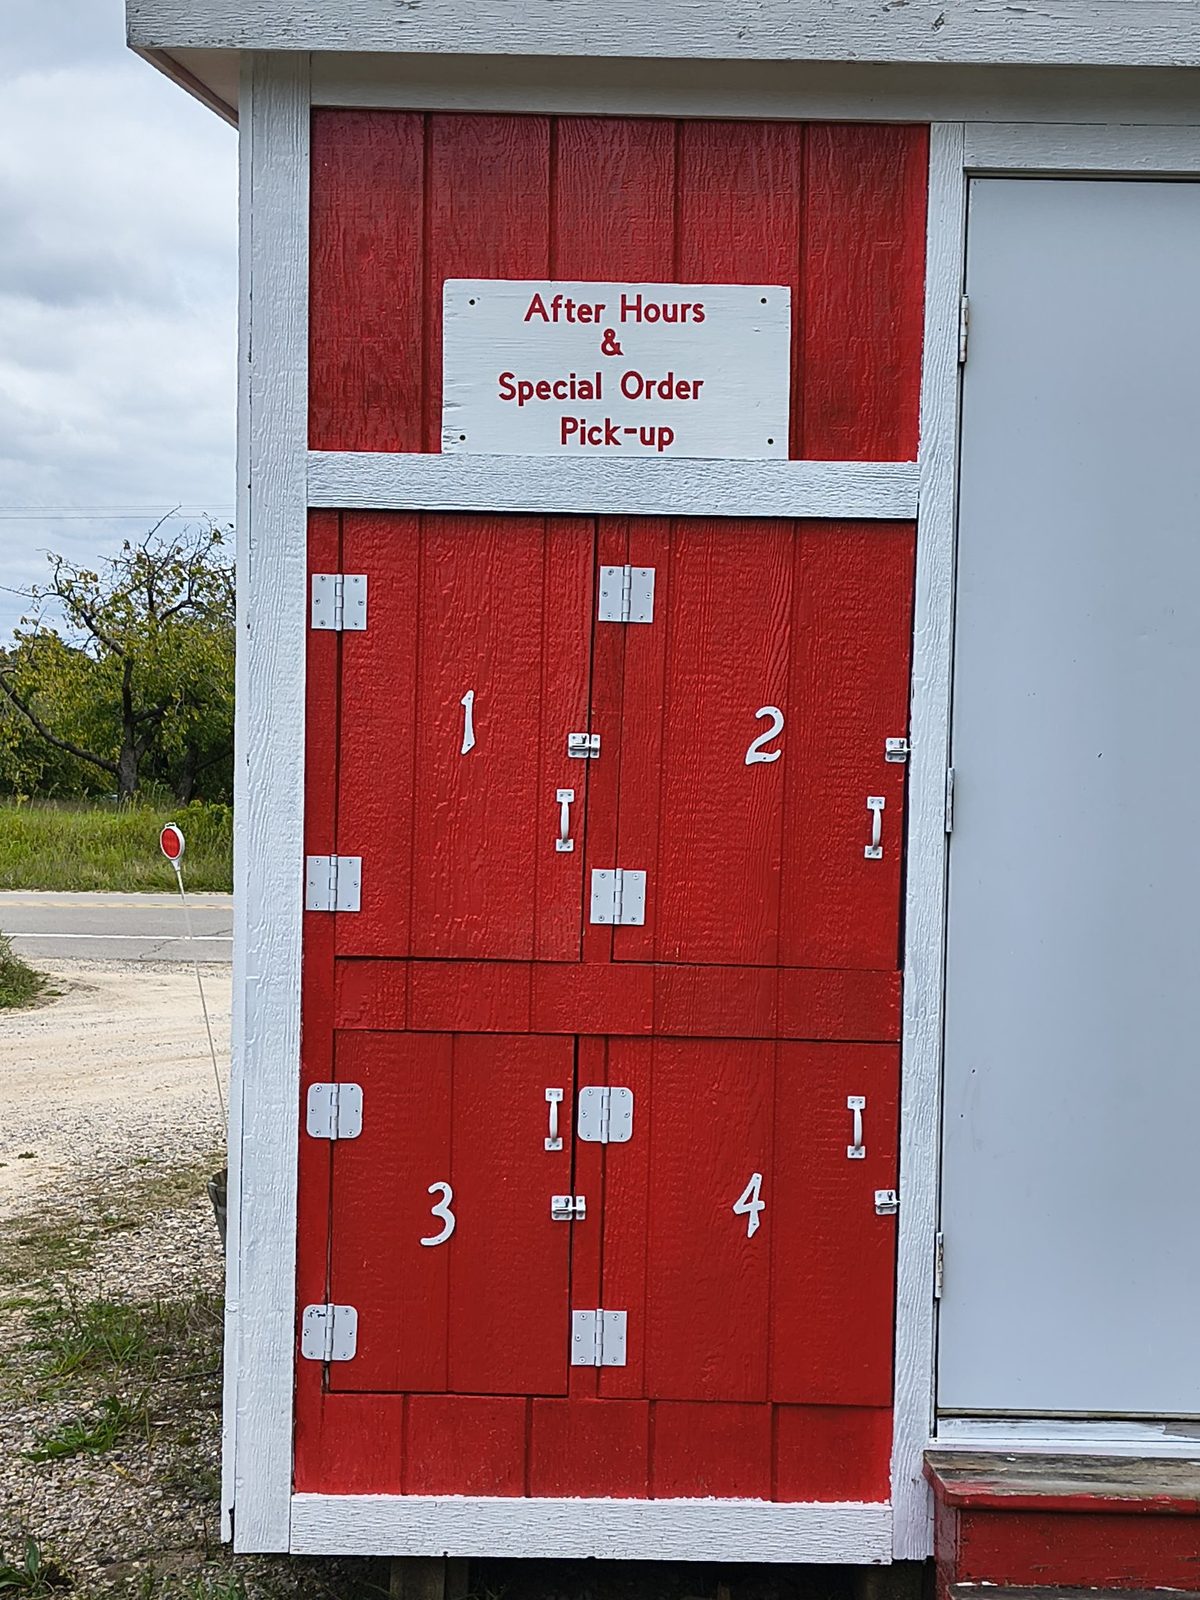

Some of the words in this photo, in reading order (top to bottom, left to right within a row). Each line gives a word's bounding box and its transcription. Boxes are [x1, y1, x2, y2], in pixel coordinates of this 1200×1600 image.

[524, 293, 606, 323] After
[620, 294, 705, 323] Hours
[600, 328, 624, 357] &
[498, 371, 602, 406] Special
[620, 371, 705, 400] Order
[561, 416, 675, 452] Pick-up
[460, 689, 477, 755] 1
[744, 705, 785, 766] 2
[420, 1181, 456, 1247] 3
[732, 1172, 766, 1239] 4
